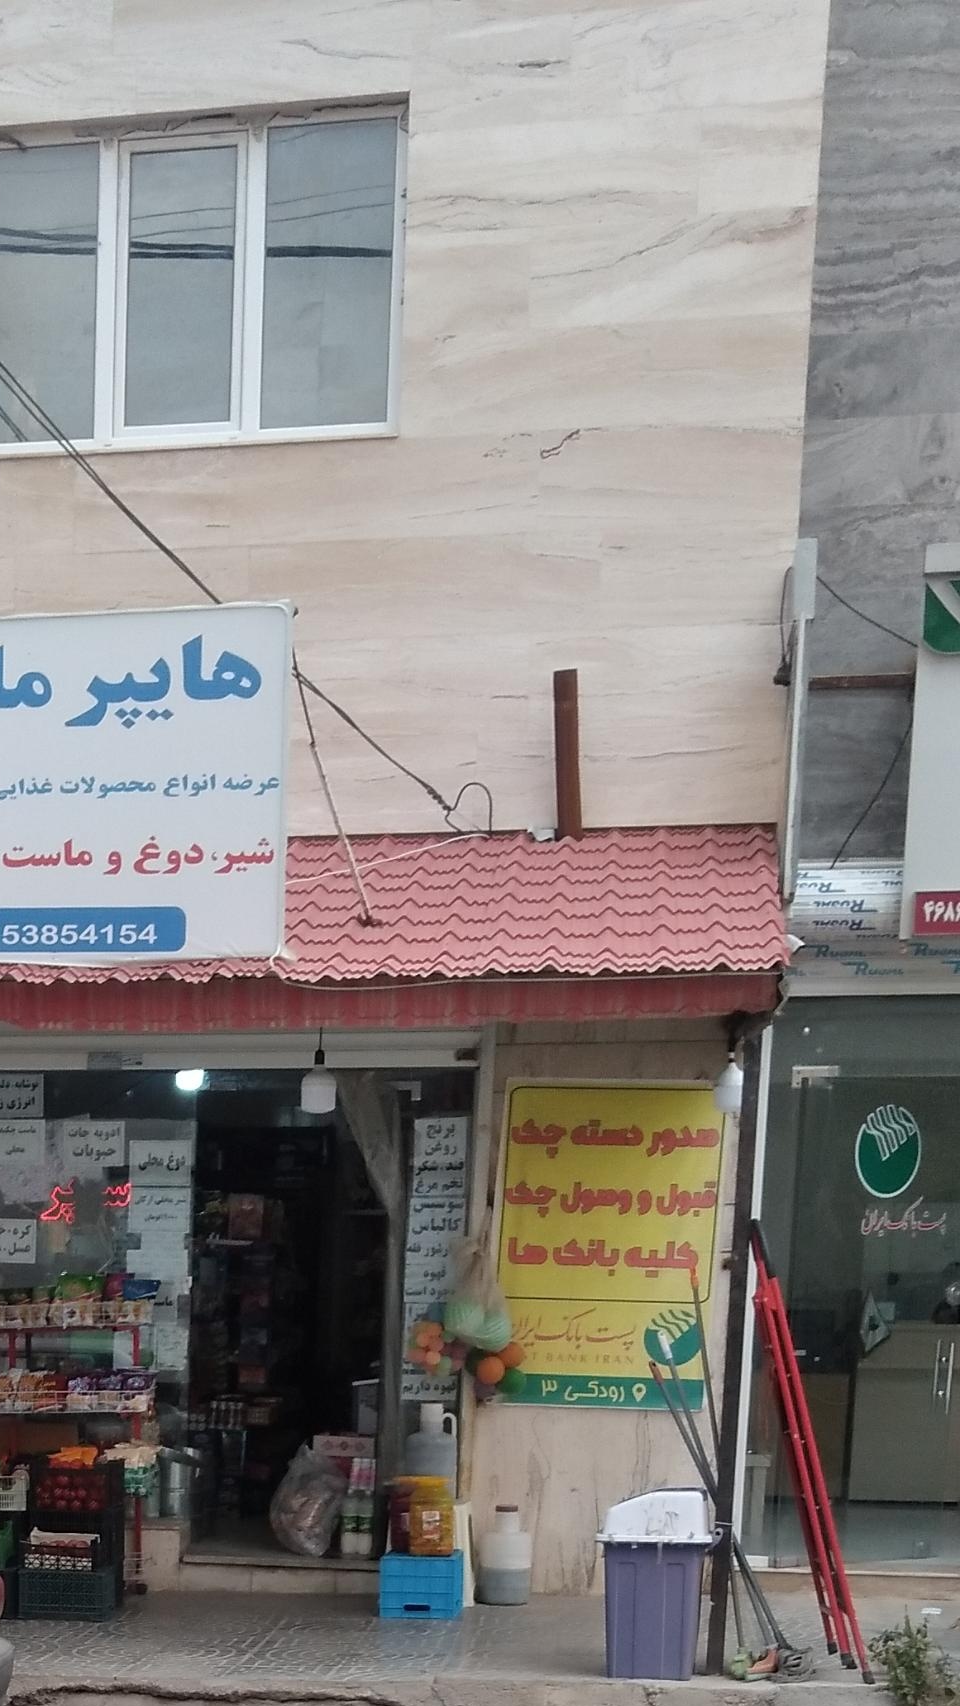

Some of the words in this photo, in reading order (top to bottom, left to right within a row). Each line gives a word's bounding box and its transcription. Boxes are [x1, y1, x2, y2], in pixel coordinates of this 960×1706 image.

[65, 634, 262, 729] هایپر
[59, 776, 157, 799] محصولات
[163, 773, 216, 797] انواع
[223, 774, 280, 795] عرضه
[2, 838, 93, 868] ماست
[102, 850, 123, 875] و
[133, 836, 204, 874] دوغ
[511, 1118, 567, 1158] چک
[570, 1120, 644, 1147] دسته
[647, 1124, 721, 1157] صدور
[72, 1144, 117, 1161] حبوبات
[504, 1180, 557, 1218] چک
[560, 1181, 633, 1214] وصول
[637, 1188, 653, 1216] و
[656, 1181, 717, 1217] قبول
[861, 1208, 888, 1238] ایران
[917, 1210, 947, 1236] پست
[507, 1238, 548, 1265] ها
[552, 1240, 619, 1276] بانک
[624, 1240, 700, 1278] کلیه
[534, 1307, 597, 1349] بانک
[585, 1325, 637, 1350] پست
[547, 1353, 587, 1363] BANK
[595, 1352, 635, 1365] IRAN
[541, 1379, 558, 1397] ۳
[564, 1380, 625, 1402] رودکی
